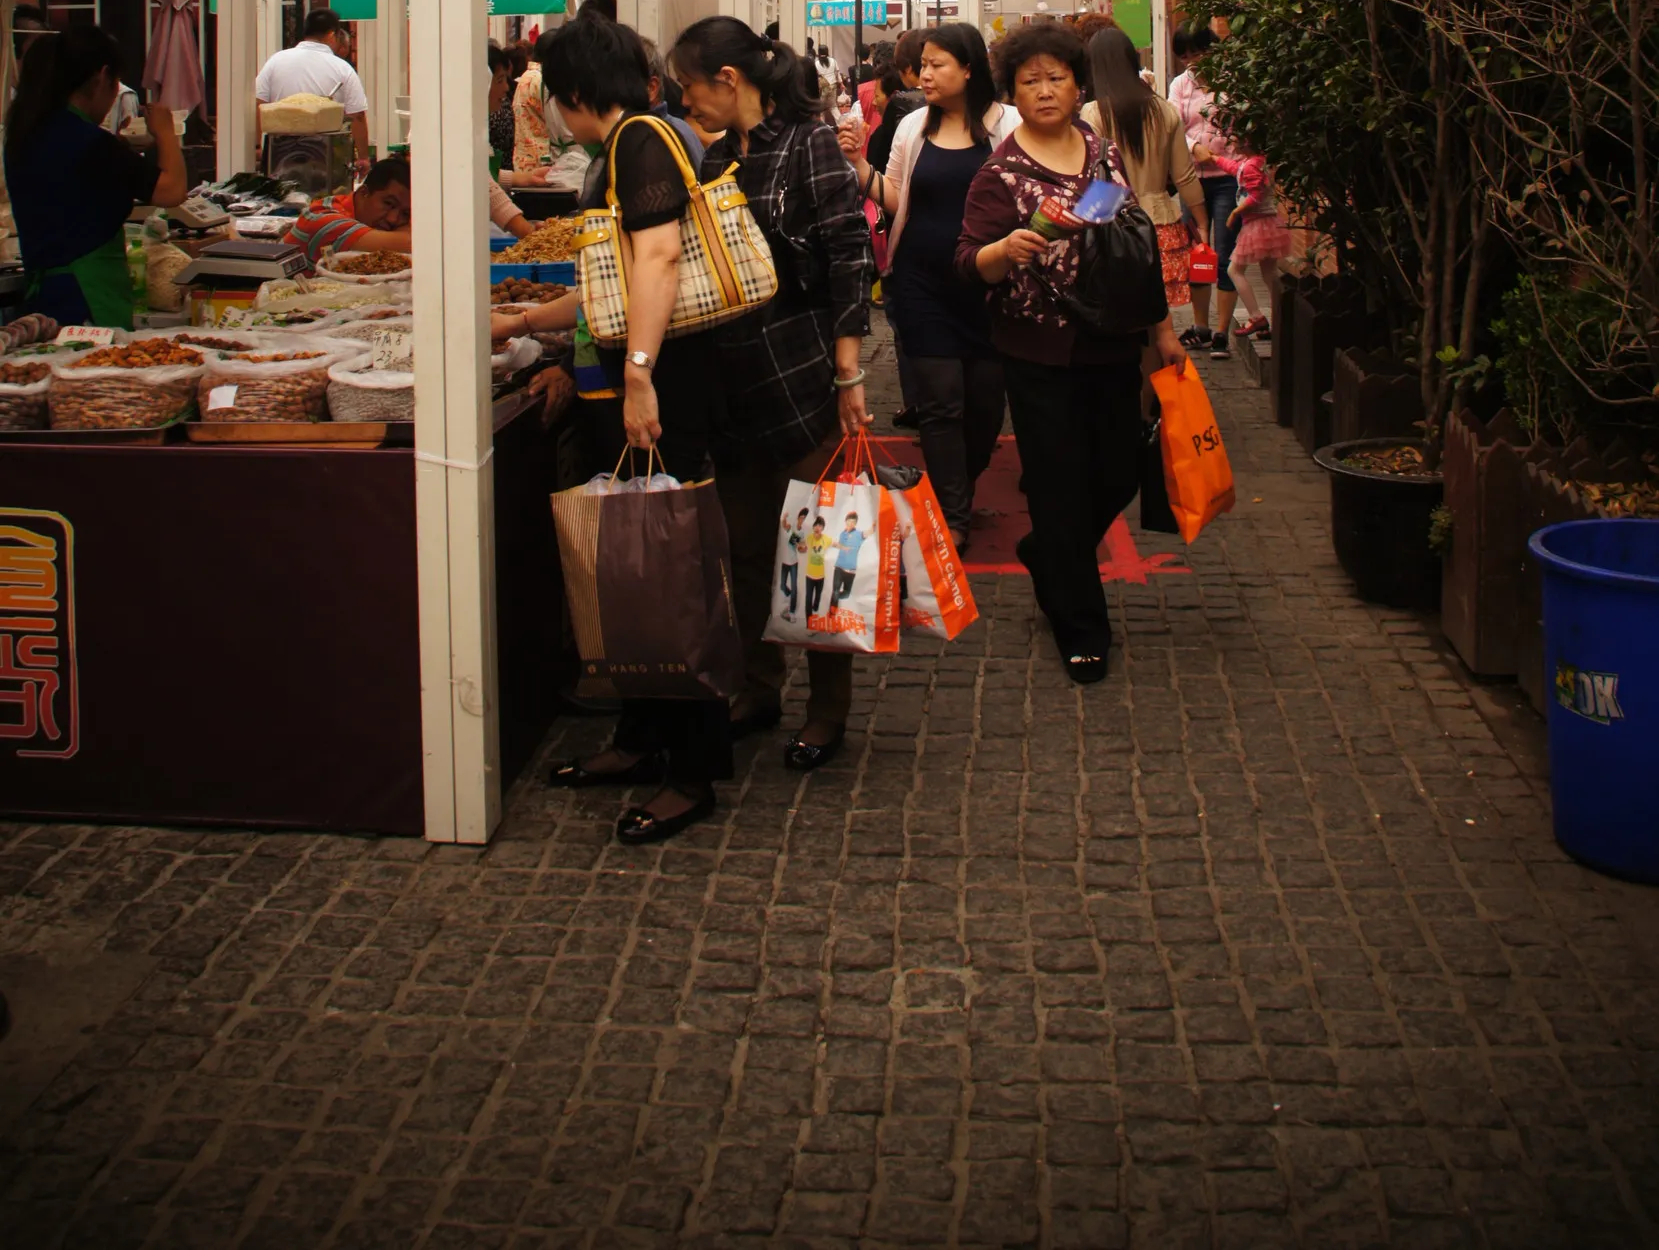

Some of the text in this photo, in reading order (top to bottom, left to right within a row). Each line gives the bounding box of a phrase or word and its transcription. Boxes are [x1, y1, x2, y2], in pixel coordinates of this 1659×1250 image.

[924, 499, 950, 561] eastern
[945, 562, 967, 611] camel
[658, 662, 687, 674] TEN
